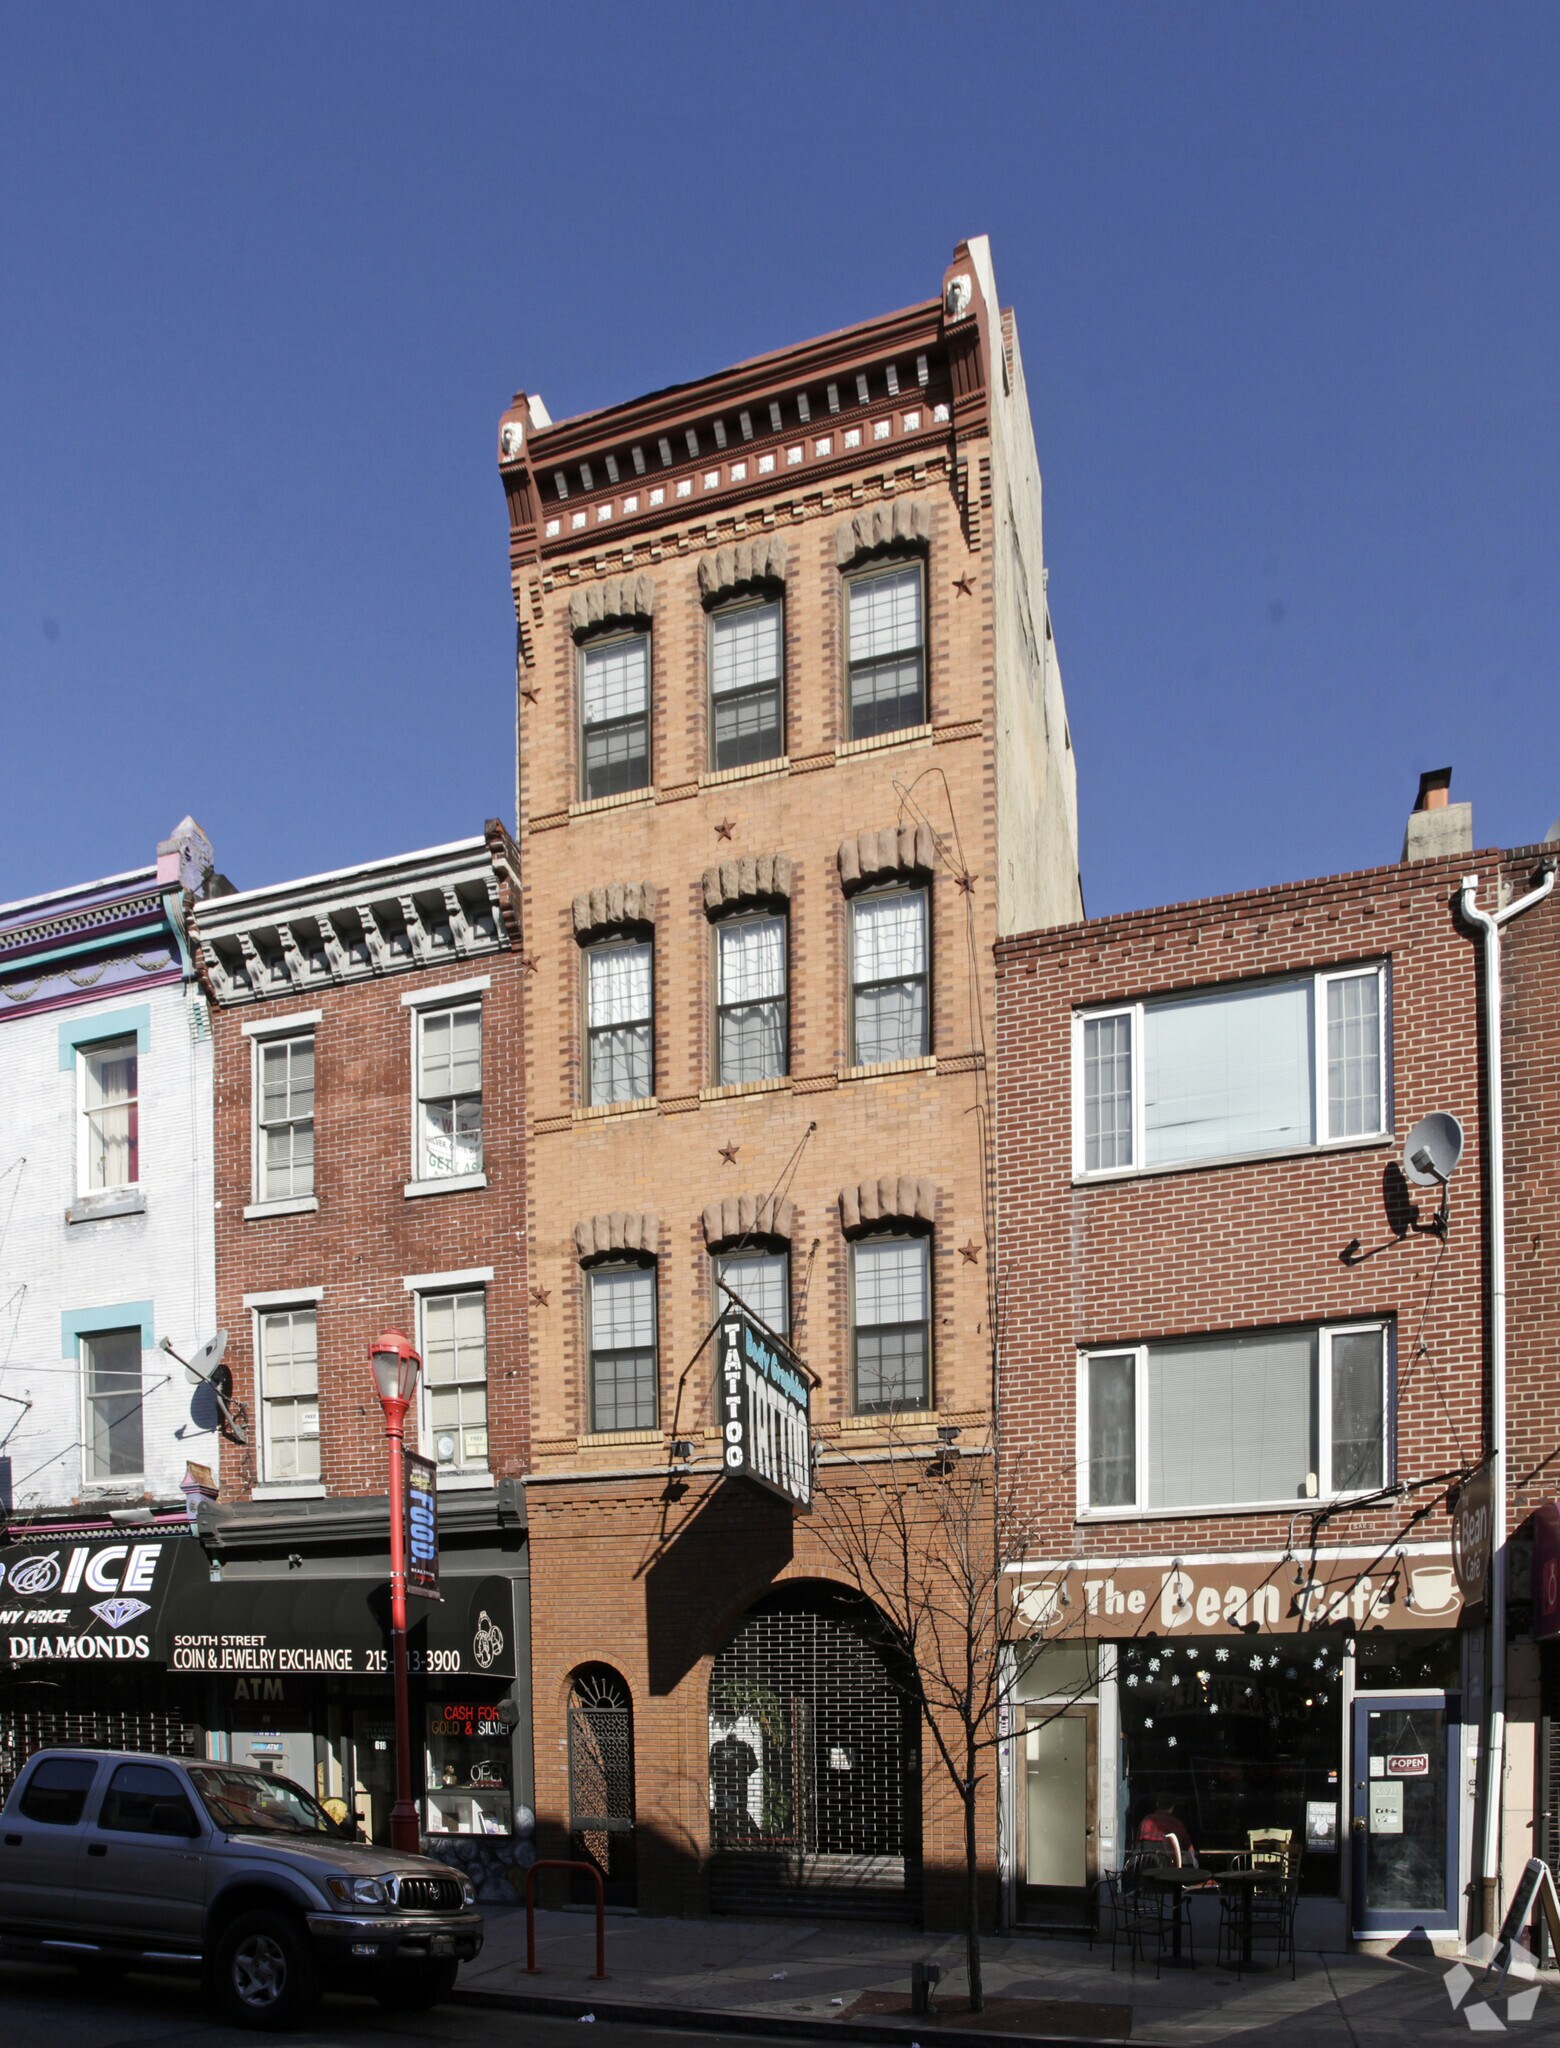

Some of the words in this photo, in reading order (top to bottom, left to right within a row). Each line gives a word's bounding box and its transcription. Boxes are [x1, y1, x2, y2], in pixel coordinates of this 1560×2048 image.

[429, 1154, 453, 1171] GET
[746, 1326, 770, 1378] Body
[770, 1352, 808, 1408] Graphics
[724, 1323, 744, 1468] TATTOO
[745, 1362, 811, 1504] TATTOO
[410, 1489, 435, 1564] FOOD.
[1462, 1505, 1487, 1553] Bean
[61, 1544, 162, 1594] ICE
[1082, 1579, 1147, 1615] The
[1160, 1571, 1280, 1628] Bean
[1299, 1576, 1395, 1622] Café
[23, 1609, 72, 1624] PRICE
[9, 1635, 150, 1659] DIAMONDS
[174, 1635, 218, 1646] SOUTH
[220, 1635, 267, 1646] STREET
[173, 1648, 205, 1669] COIN
[207, 1648, 218, 1669] &
[219, 1649, 277, 1669] JEWELRY
[279, 1649, 353, 1670] EXCHANGE
[365, 1650, 461, 1672] 215-13-3900
[234, 1678, 285, 1701] ATM
[444, 1706, 474, 1720] CASH
[431, 1721, 460, 1735] GOLD
[464, 1721, 473, 1735] &
[1397, 1758, 1424, 1768] OPEN
